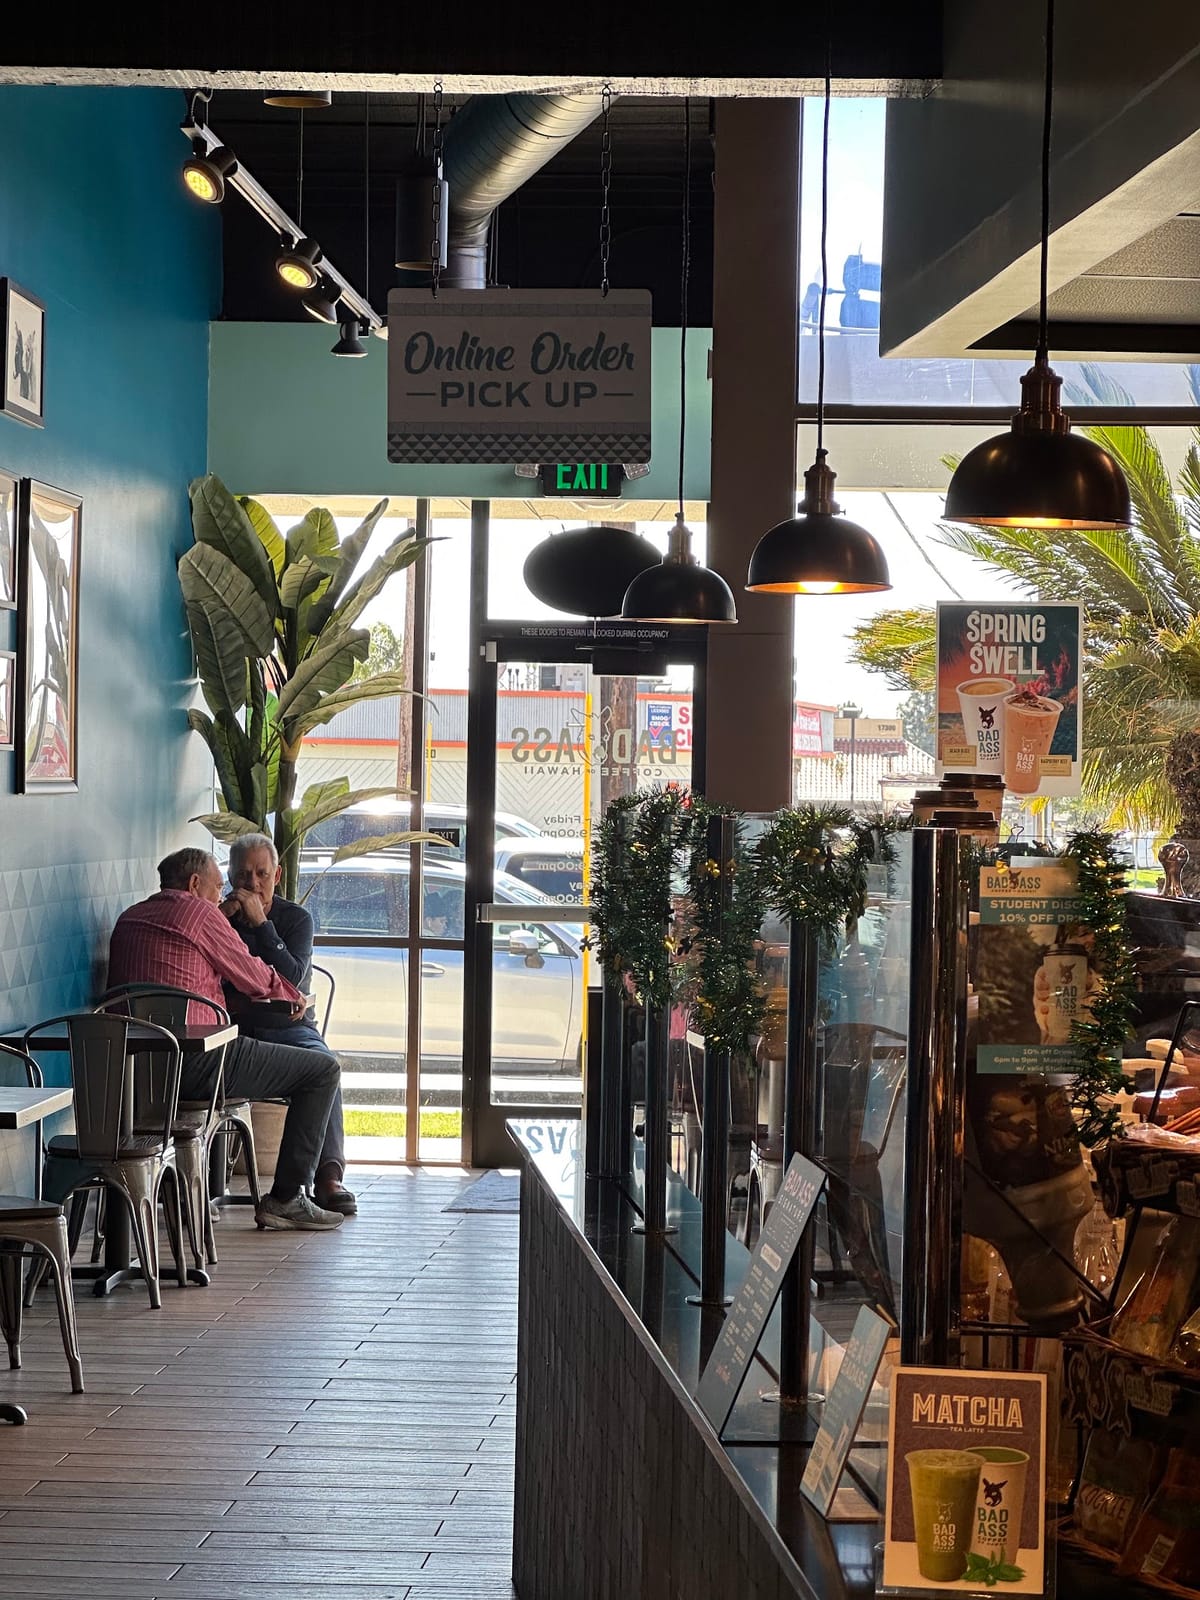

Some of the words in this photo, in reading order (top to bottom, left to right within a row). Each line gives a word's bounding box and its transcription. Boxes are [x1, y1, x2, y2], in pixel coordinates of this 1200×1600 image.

[404, 331, 515, 375] Online
[531, 331, 635, 375] Order
[440, 381, 531, 408] PICK
[545, 381, 598, 408] UP
[556, 463, 608, 490] EXIT
[521, 627, 539, 636] THESE
[539, 627, 558, 636] DOORS
[616, 629, 637, 638] DURING
[637, 629, 670, 639] OCCUPANCY
[966, 610, 1046, 643] SPRING
[970, 642, 1046, 675] SWELL
[977, 730, 1000, 741] BAD
[979, 742, 1000, 753] ASS
[1016, 752, 1035, 762] BAD
[1015, 761, 1034, 770] ASS
[987, 876, 1009, 888] BAD
[1020, 876, 1041, 889] ASS
[990, 900, 1049, 910] STUDENT
[1000, 914, 1025, 923] 10%
[1029, 914, 1054, 923] OFF
[1056, 985, 1077, 998] BAD
[1056, 998, 1077, 1009] ASS
[912, 1393, 1023, 1428] MATCHA
[978, 1507, 1008, 1522] BAD
[932, 1523, 956, 1536] BAD
[978, 1522, 1008, 1537] ASS
[933, 1535, 956, 1547] ASS
